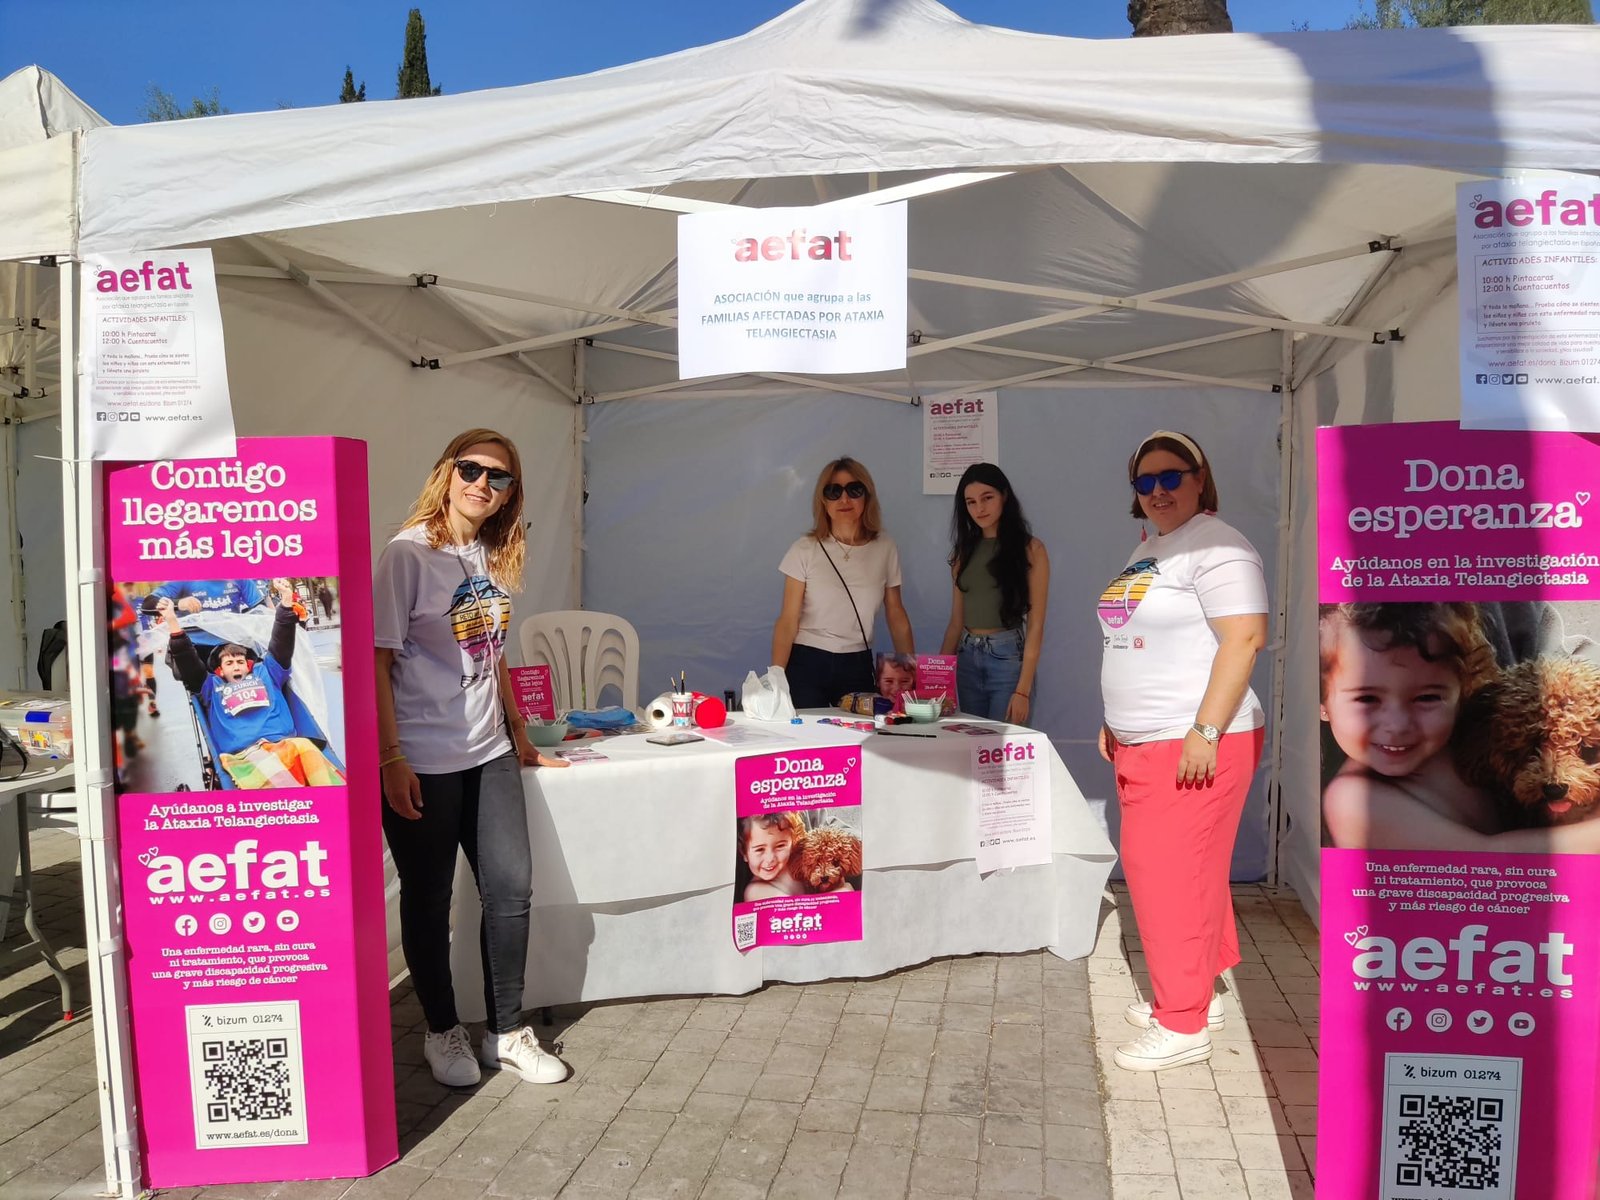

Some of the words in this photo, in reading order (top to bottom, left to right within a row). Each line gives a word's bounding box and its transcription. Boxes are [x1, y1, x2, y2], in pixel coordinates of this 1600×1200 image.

[1474, 190, 1600, 228] aefat
[734, 228, 852, 262] aefat
[1482, 256, 1541, 266] ACTIVIDADES
[97, 261, 192, 292] aefat
[714, 290, 780, 304] ASOCIACIÓN
[784, 293, 804, 304] que
[807, 294, 843, 304] agrupa
[856, 292, 871, 302] las
[702, 312, 749, 325] FAMILIAS
[752, 311, 815, 321] AFECTADAS
[819, 312, 841, 321] POR
[844, 310, 884, 321] ATAXIA
[746, 328, 836, 339] TELANGIECTASIA
[931, 399, 984, 415] aefat
[151, 461, 286, 493] Contigo
[1404, 459, 1524, 492] Dona
[122, 498, 318, 530] llegaremos
[1349, 500, 1582, 539] esperanza
[139, 531, 214, 559] más
[221, 530, 303, 564] lejos
[1330, 557, 1422, 573] Ayúdanos
[1427, 558, 1450, 568] en
[1454, 556, 1472, 568] la
[1476, 553, 1599, 571] investigación
[1342, 574, 1363, 587] de
[1367, 574, 1384, 586] la
[1388, 573, 1450, 586] Ataxia
[1454, 571, 1588, 587] Telangiectasia
[237, 690, 257, 700] 104
[522, 692, 544, 701] aefat
[978, 742, 1035, 763] aefat
[774, 758, 824, 774] Dona
[750, 774, 846, 795] esperanza
[149, 804, 223, 818] Ayúdanos
[239, 799, 313, 812] investigar
[144, 820, 159, 830] la
[162, 818, 211, 830] Ataxia
[214, 813, 319, 828] Telangiectasia
[147, 839, 330, 894] aefat
[1366, 862, 1390, 872] Una
[1393, 863, 1467, 874] enfermedad
[1470, 866, 1501, 877] rara,
[1505, 867, 1524, 875] sin
[1527, 868, 1557, 877] cura
[1375, 876, 1386, 884] ni
[1389, 876, 1467, 887] tratamiento,
[1470, 879, 1492, 888] que
[1496, 879, 1547, 889] provoca
[149, 889, 331, 905] www.aefat.es
[1352, 889, 1376, 897] una
[1379, 889, 1413, 899] grave
[1416, 889, 1496, 900] discapacidad
[1500, 892, 1570, 903] progresiva
[1389, 901, 1397, 912] y
[1400, 901, 1425, 911] más
[1429, 902, 1466, 913] riesgo
[1469, 903, 1484, 912] de
[1487, 904, 1530, 914] cáncer
[771, 912, 822, 930] aefat
[162, 948, 182, 956] Una
[184, 945, 244, 956] enfermedad
[1352, 924, 1574, 986] aefat
[182, 956, 246, 966] tratamiento,
[248, 956, 266, 964] que
[269, 953, 309, 962] provoca
[174, 969, 203, 978] grave
[205, 965, 270, 977] discapacidad
[273, 963, 328, 973] progresiva
[183, 980, 190, 989] y
[193, 979, 213, 987] más
[216, 978, 246, 987] riesgo
[249, 976, 261, 984] de
[1353, 982, 1574, 999] www.aefat.es
[217, 1016, 247, 1025] bizum
[253, 1014, 283, 1024] 01274
[1421, 1067, 1457, 1078] bizum
[1464, 1070, 1501, 1080] 01274
[206, 1129, 298, 1140] www.aefat.es/dona
